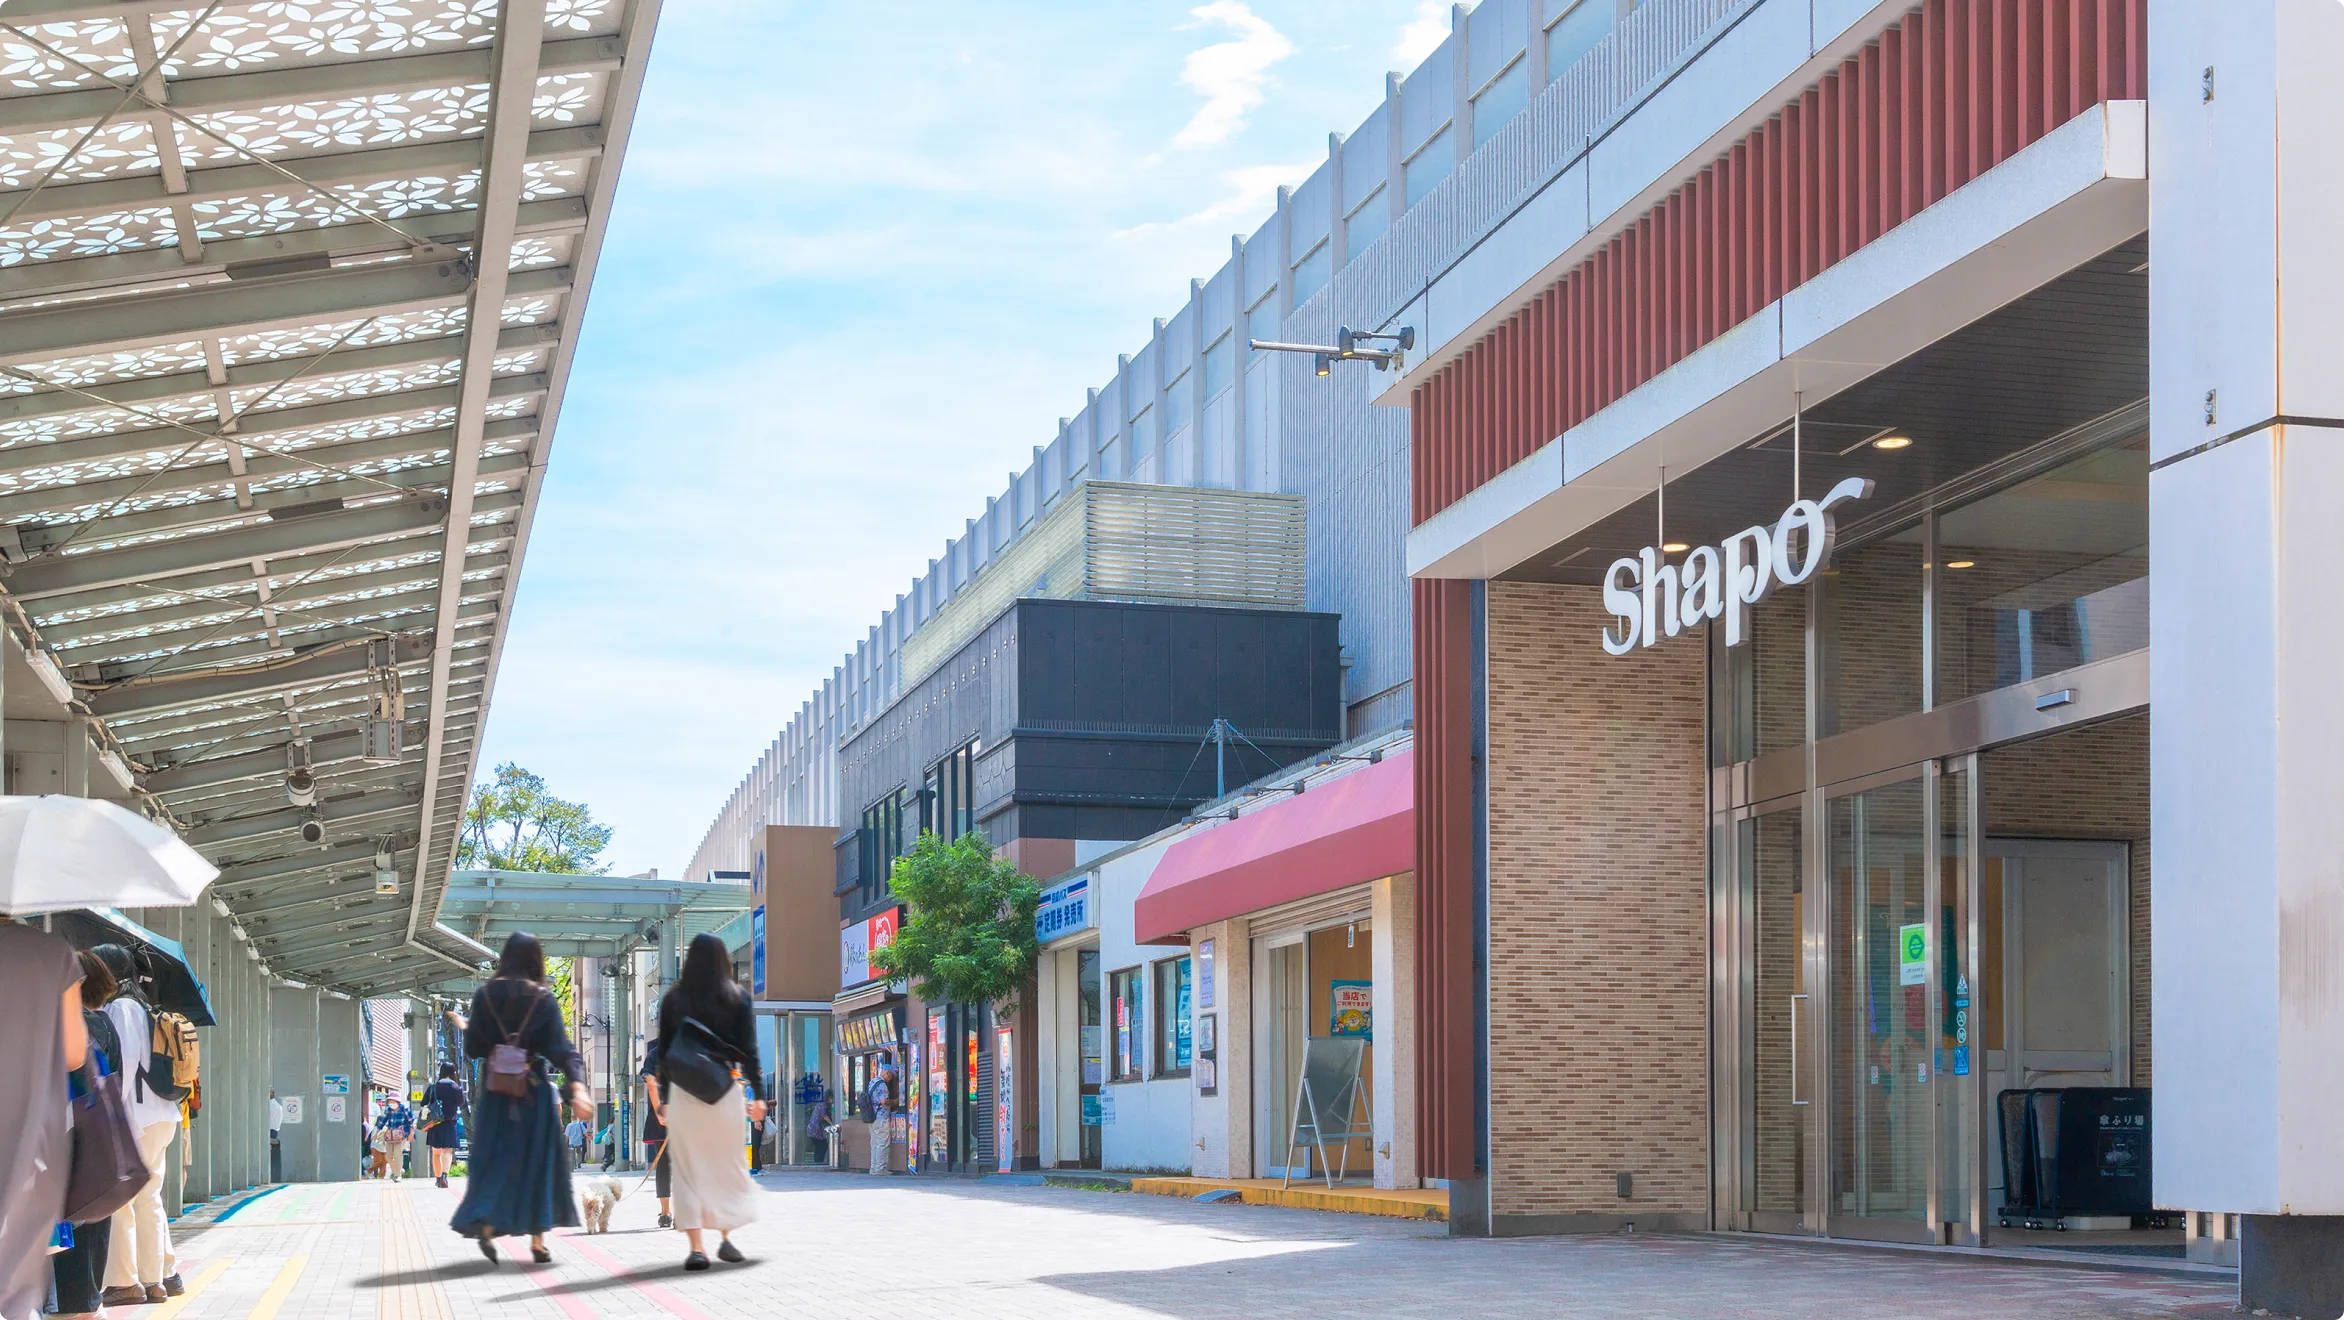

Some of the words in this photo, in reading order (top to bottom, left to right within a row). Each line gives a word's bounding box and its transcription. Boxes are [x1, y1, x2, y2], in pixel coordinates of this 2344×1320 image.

[1602, 477, 1876, 656] shapo
[1342, 991, 1367, 1001] 当店で
[2099, 1114, 2145, 1126] 傘ふり場
